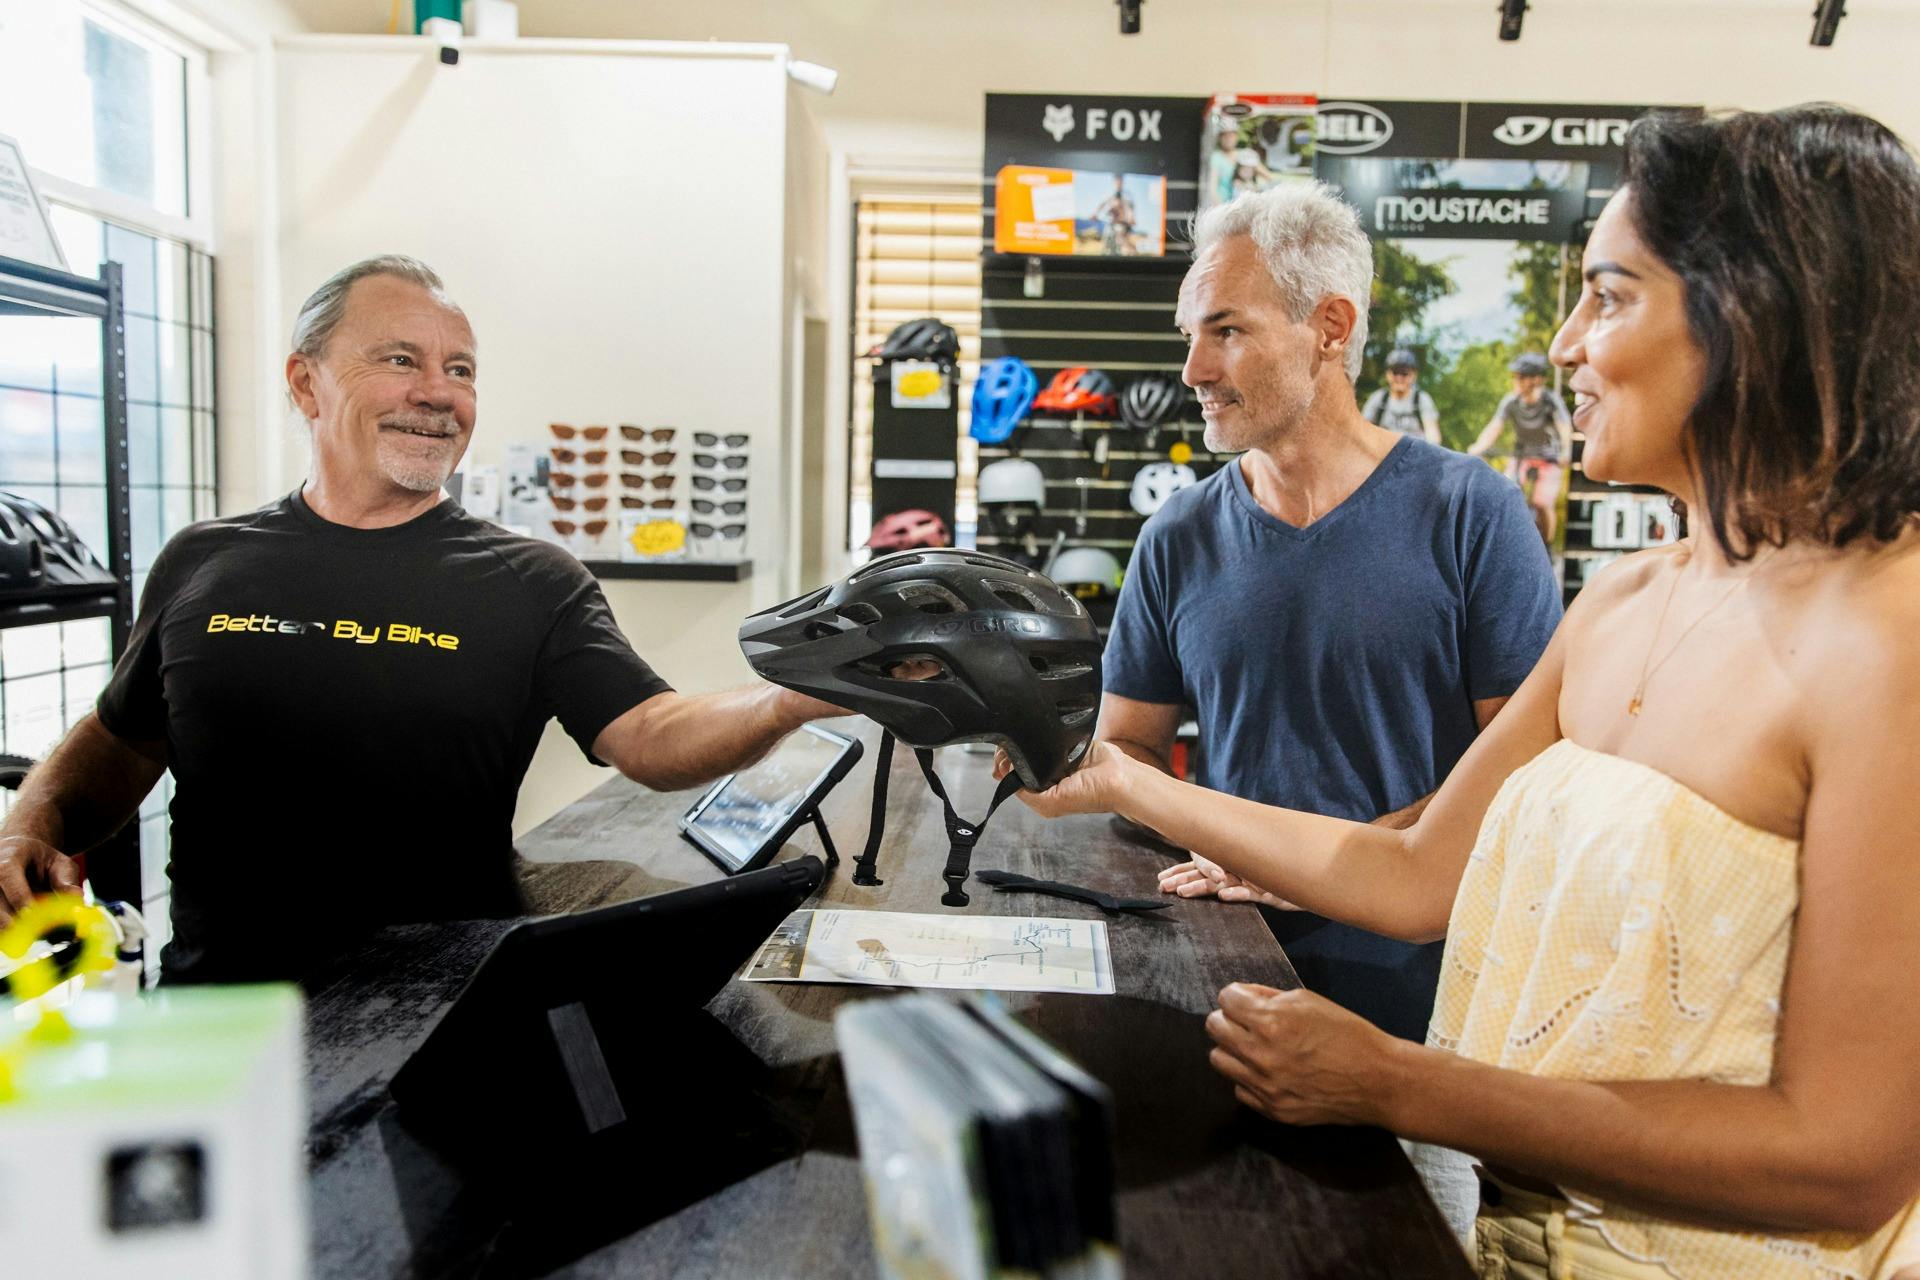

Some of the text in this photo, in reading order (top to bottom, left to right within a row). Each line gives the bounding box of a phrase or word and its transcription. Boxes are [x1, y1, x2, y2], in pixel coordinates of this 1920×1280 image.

[1086, 108, 1162, 141] FOX
[1551, 117, 1630, 146] GIR
[207, 614, 460, 651] Better By Bike
[968, 616, 1041, 634] GIRO
